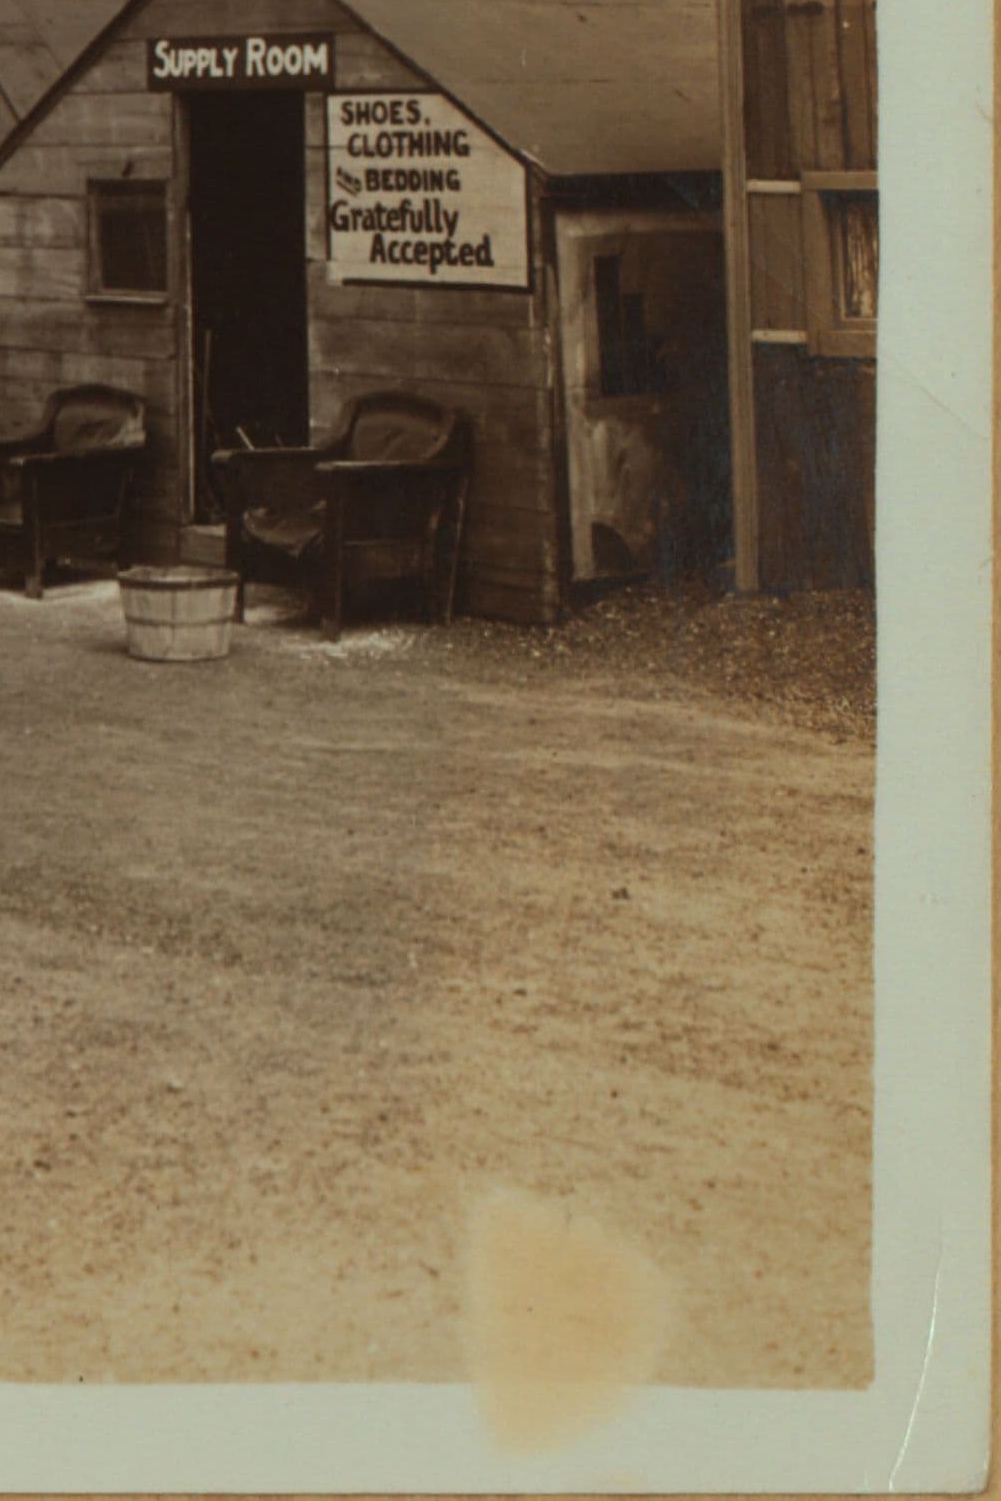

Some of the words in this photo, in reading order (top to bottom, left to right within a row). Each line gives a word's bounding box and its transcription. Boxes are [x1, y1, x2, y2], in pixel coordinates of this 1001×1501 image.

[153, 39, 238, 78] SUPPLY
[246, 37, 329, 77] ROOM
[347, 129, 471, 158] CLOTHING
[365, 168, 461, 192] BEDDING
[330, 198, 460, 237] Gratefully
[369, 233, 495, 275] Accepted
